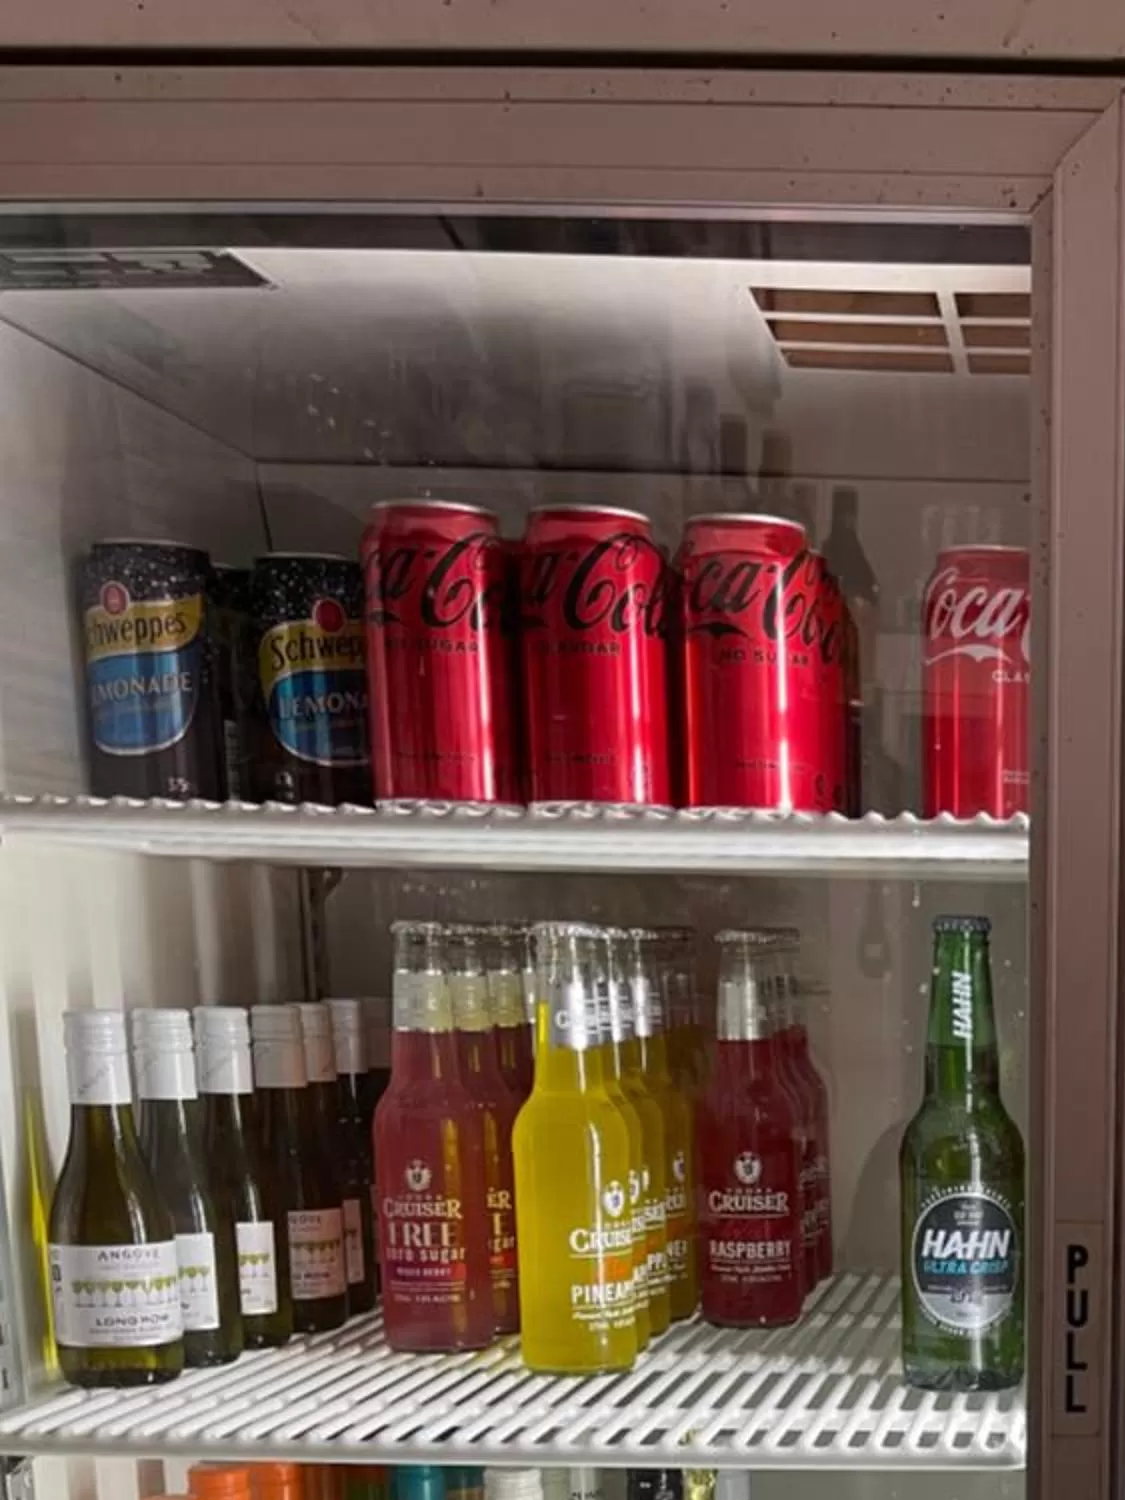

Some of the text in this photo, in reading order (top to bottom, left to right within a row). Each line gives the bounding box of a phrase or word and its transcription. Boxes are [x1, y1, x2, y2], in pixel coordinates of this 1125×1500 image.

[952, 971, 973, 1039] HAHN
[383, 1197, 463, 1220] CRUISER
[709, 1190, 790, 1215] CRUISER
[420, 1247, 466, 1265] sugar
[709, 1240, 791, 1260] RASPBERRY
[921, 1228, 1012, 1261] HAHN
[1065, 1245, 1089, 1413] PULL
